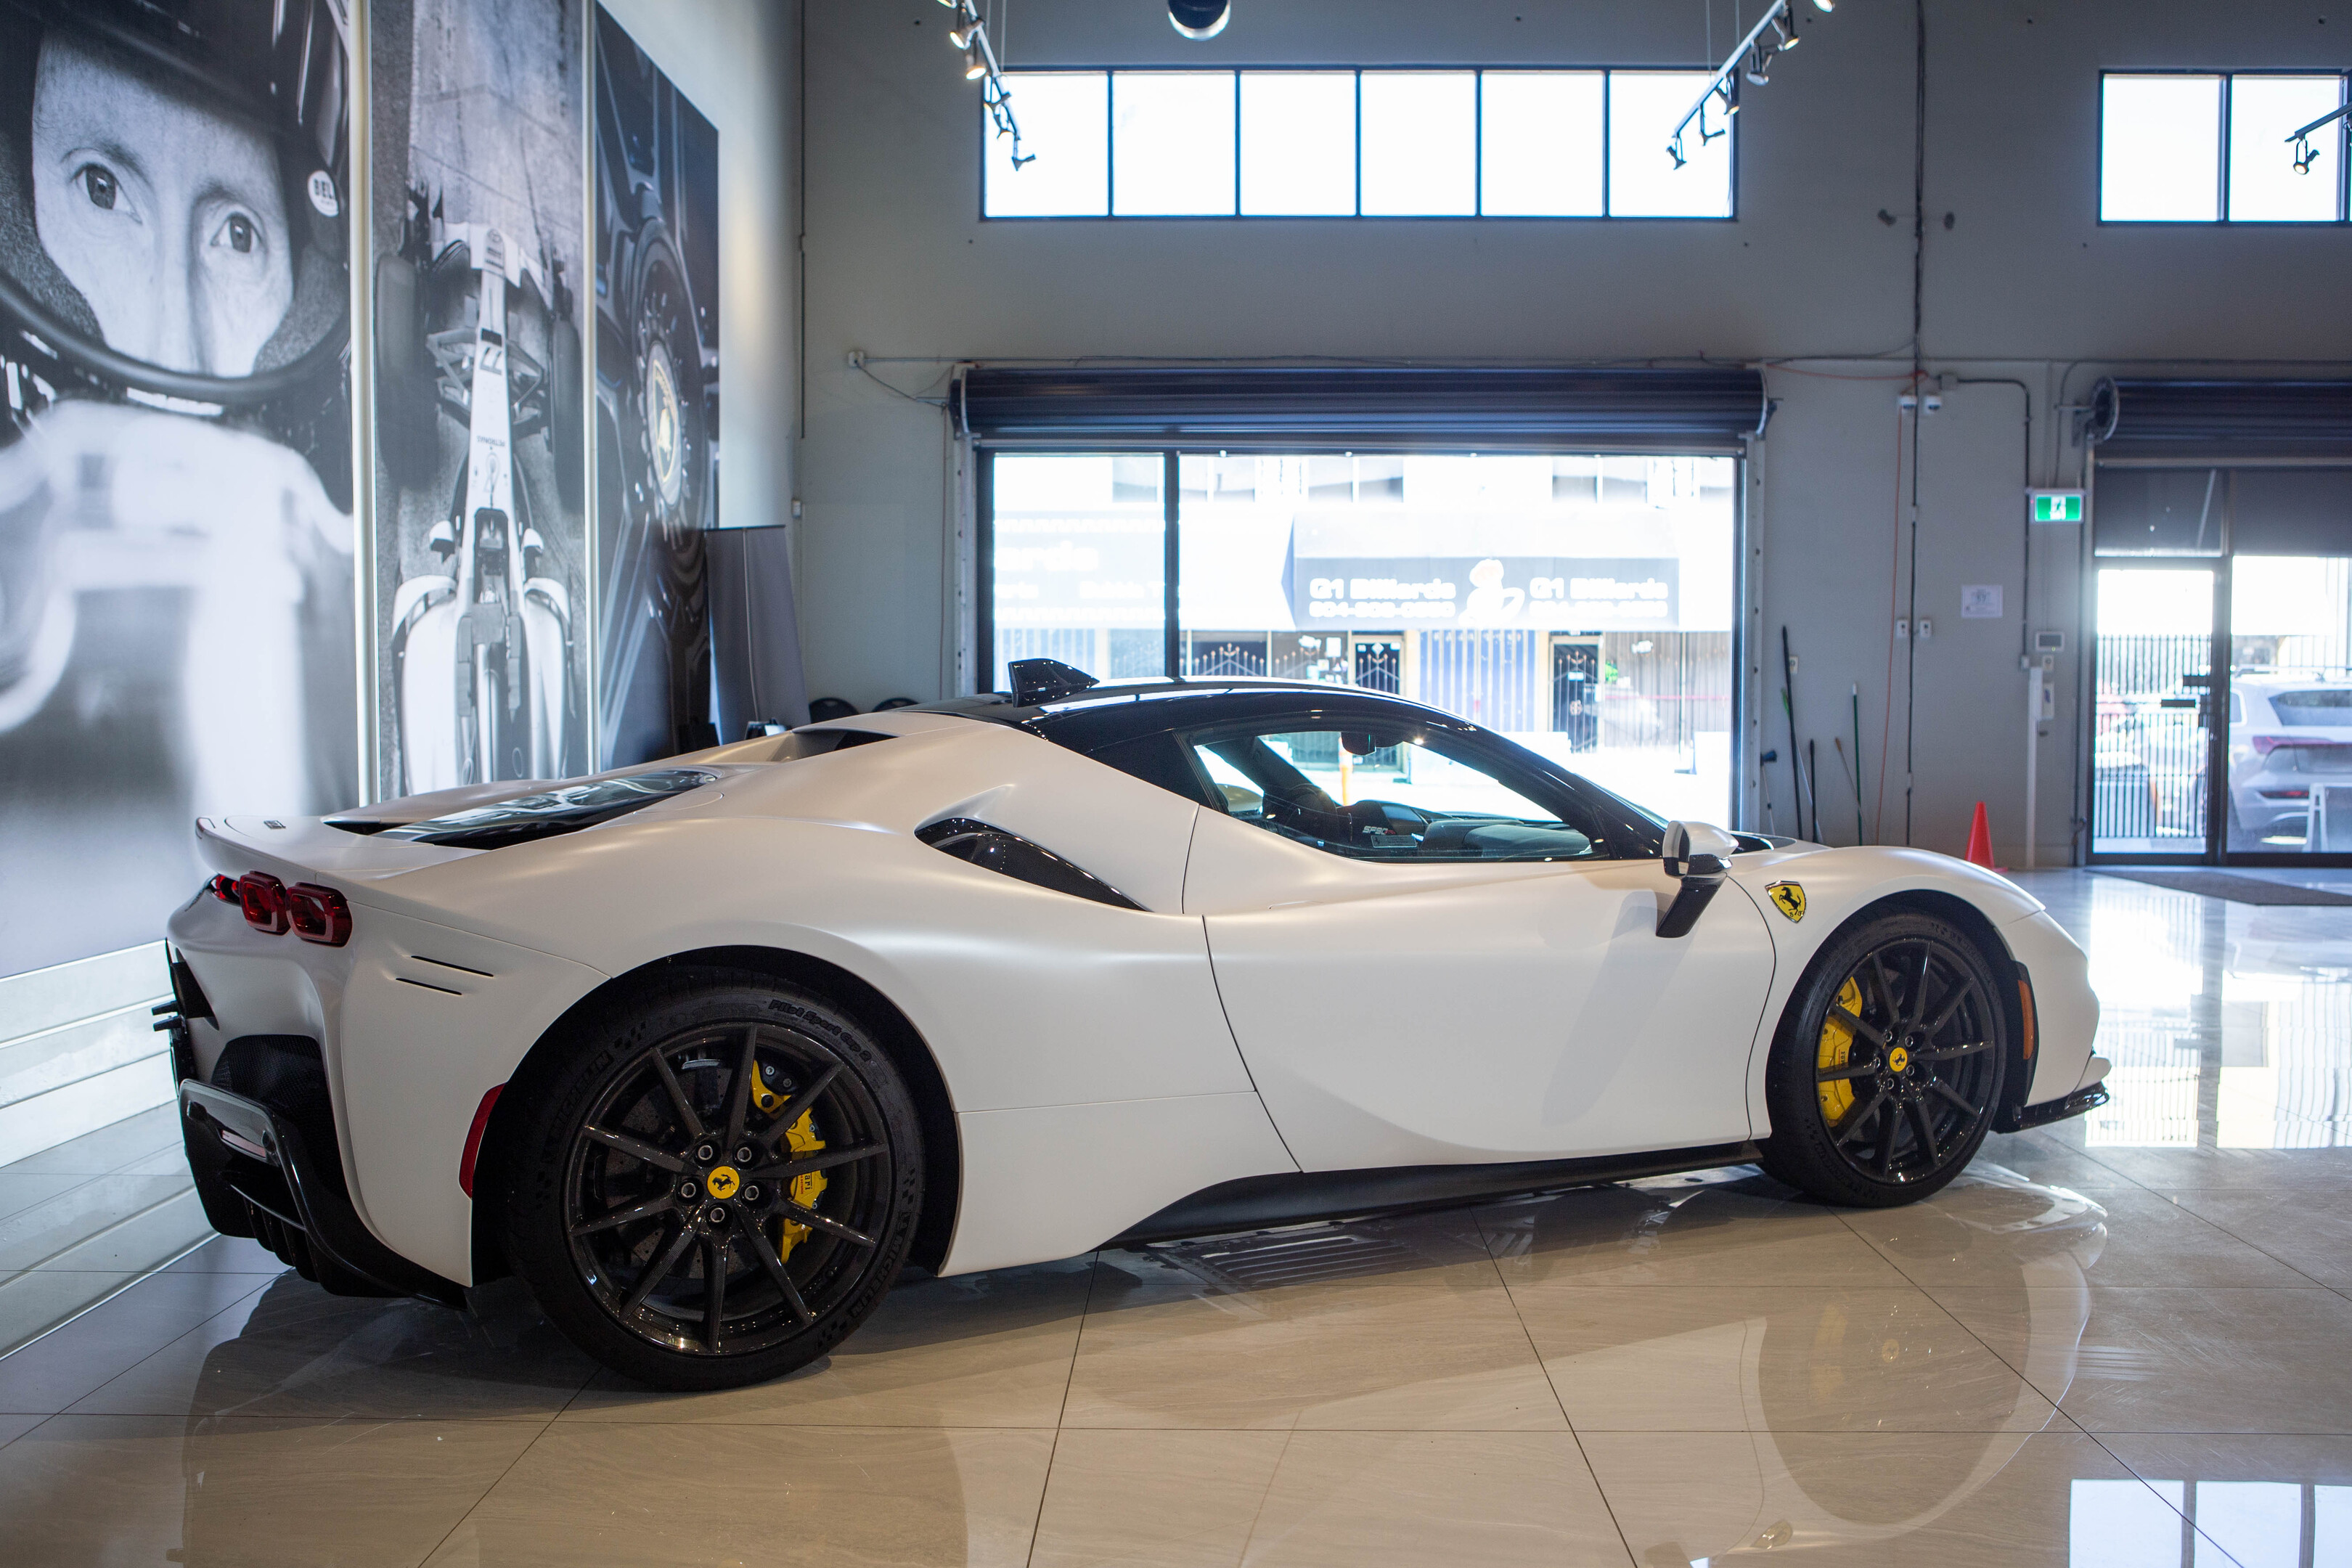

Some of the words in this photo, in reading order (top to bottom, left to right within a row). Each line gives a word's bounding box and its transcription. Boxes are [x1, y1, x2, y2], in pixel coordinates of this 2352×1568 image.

[314, 179, 334, 199] BEL
[476, 436, 506, 447] PETRONAS
[768, 999, 805, 1018] Pilot
[802, 1010, 843, 1036] Sport
[840, 1032, 862, 1053] Cup
[859, 1050, 873, 1062] 2
[846, 1233, 905, 1318] MICHELIN
